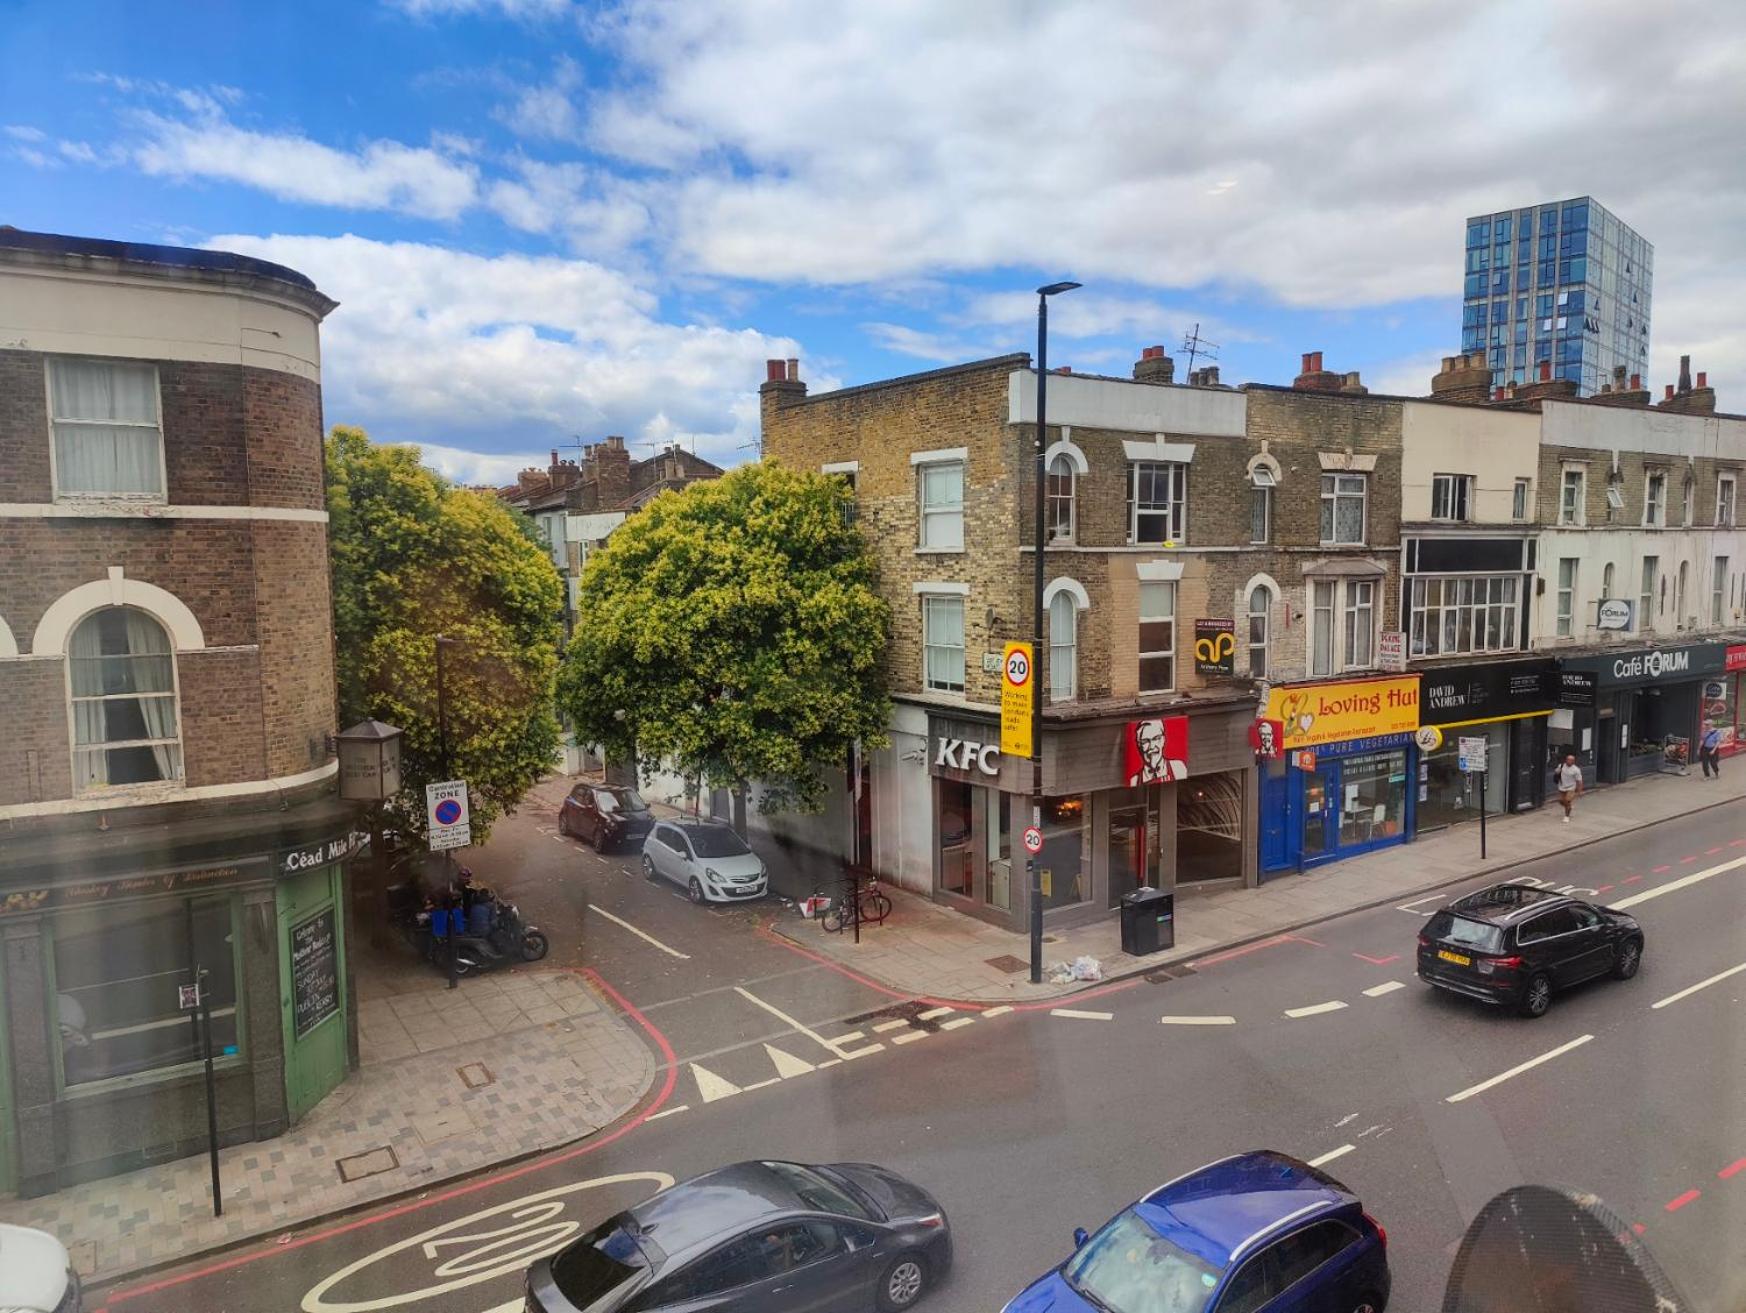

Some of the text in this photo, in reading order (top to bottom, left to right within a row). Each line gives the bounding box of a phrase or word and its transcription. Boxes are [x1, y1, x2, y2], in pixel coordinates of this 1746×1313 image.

[1601, 608, 1628, 618] FORUM
[1009, 659, 1027, 676] 20
[1613, 651, 1689, 678] Café FORUM
[1429, 685, 1455, 699] DAVID
[1429, 694, 1465, 709] ANDREW
[1318, 692, 1381, 716] Loving
[1330, 742, 1353, 753] PURE
[1359, 732, 1415, 749] VEGETARIAN
[935, 737, 1000, 775] KFC
[435, 790, 460, 800] ZONE
[1026, 833, 1040, 846] 20
[287, 847, 323, 870] Céad
[328, 839, 347, 859] Mile
[422, 1202, 580, 1278] 20
